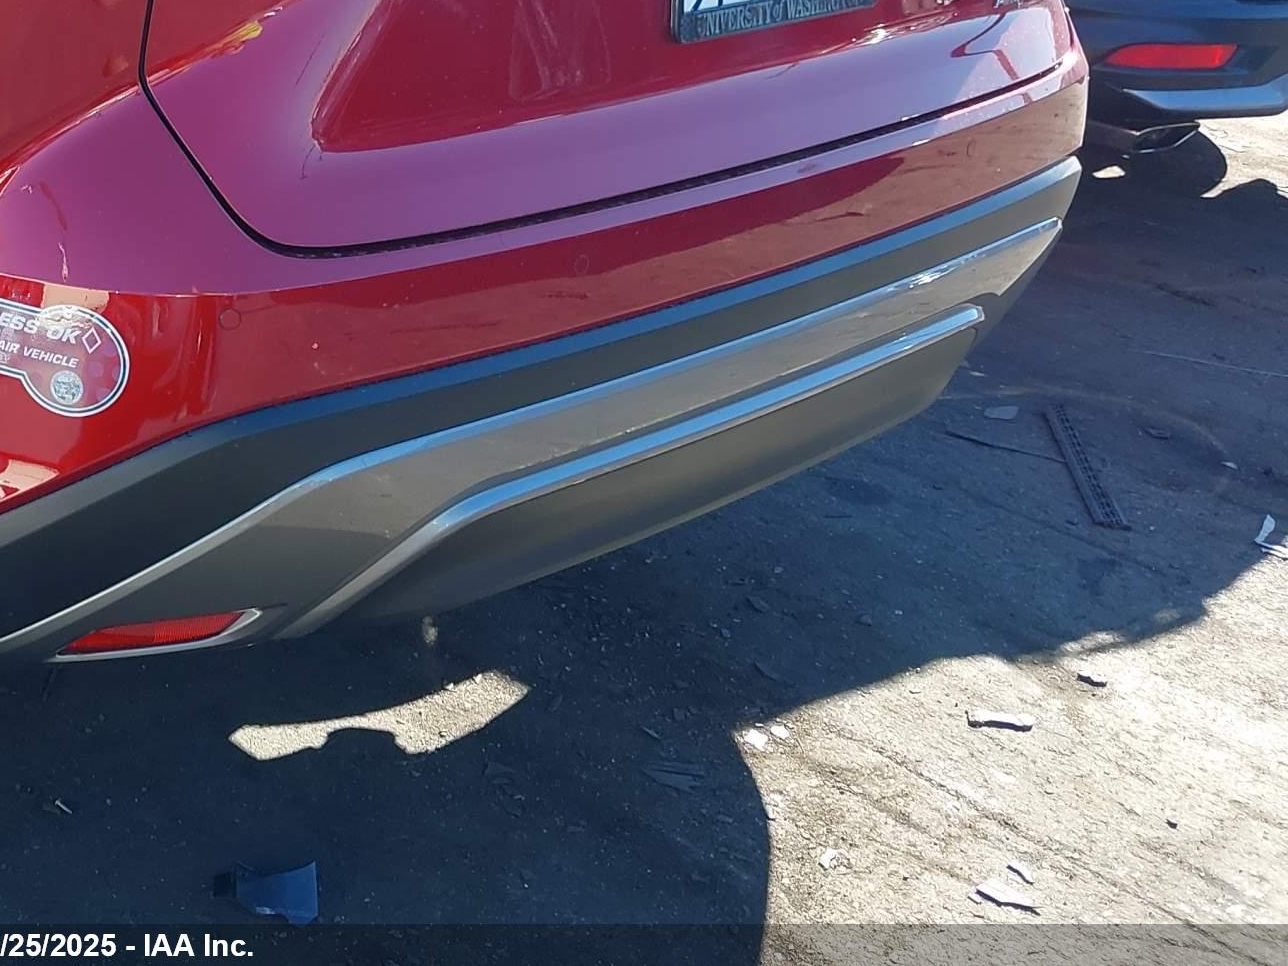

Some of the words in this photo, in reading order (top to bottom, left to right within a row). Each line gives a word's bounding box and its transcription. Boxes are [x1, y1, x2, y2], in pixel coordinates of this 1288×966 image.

[697, 1, 773, 38] UNIVERSITY
[773, 0, 785, 22] of
[46, 326, 82, 345] OK
[23, 346, 80, 369] VEHICLE
